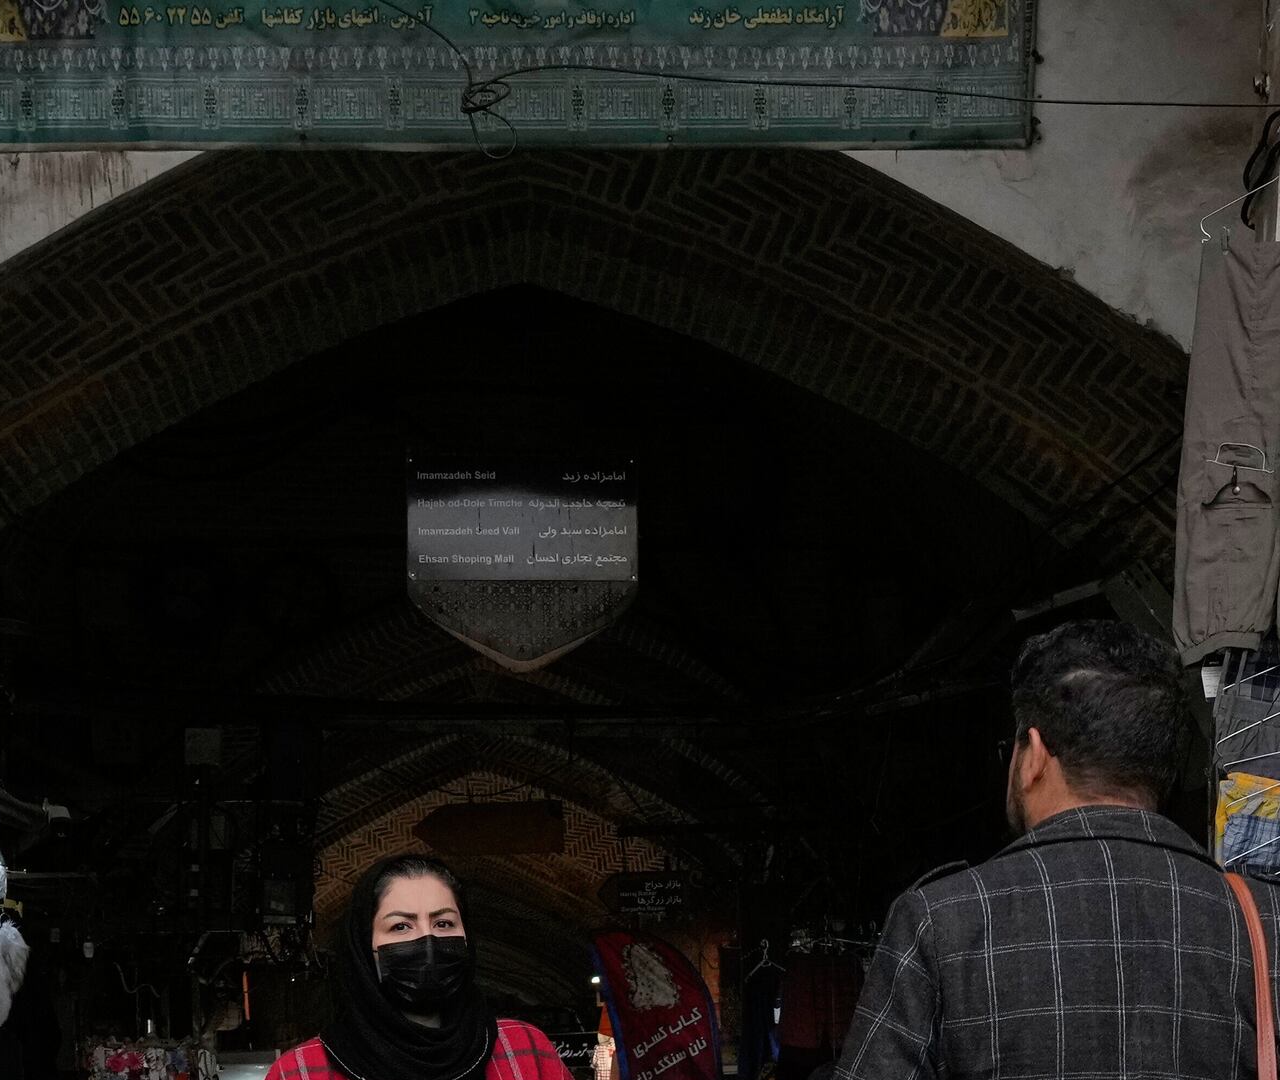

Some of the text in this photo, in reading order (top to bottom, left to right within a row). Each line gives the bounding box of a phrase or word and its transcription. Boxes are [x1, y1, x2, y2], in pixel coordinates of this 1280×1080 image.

[215, 6, 244, 29] تلفن
[305, 6, 337, 30] بازار
[337, 6, 379, 30] انتهای
[543, 10, 566, 29] امور
[575, 8, 606, 29] اوقاف
[607, 9, 635, 28] اداره
[689, 4, 845, 29] آرامگاه لطفعلی خان زند
[417, 471, 472, 480] Imamzadeh
[583, 471, 626, 482] امامزاده
[417, 498, 446, 510] Hajeb
[488, 498, 523, 508] Timche
[418, 526, 473, 536] Imamzadeh
[502, 526, 520, 536] Vali
[538, 525, 557, 539] ولی
[584, 525, 627, 538] امامزاده
[418, 554, 514, 565] Ehsan Shoping Mall
[526, 552, 628, 567] مجتمع تجاری احسان
[632, 1007, 703, 1059] کباب کسری
[688, 1036, 708, 1057] نان
